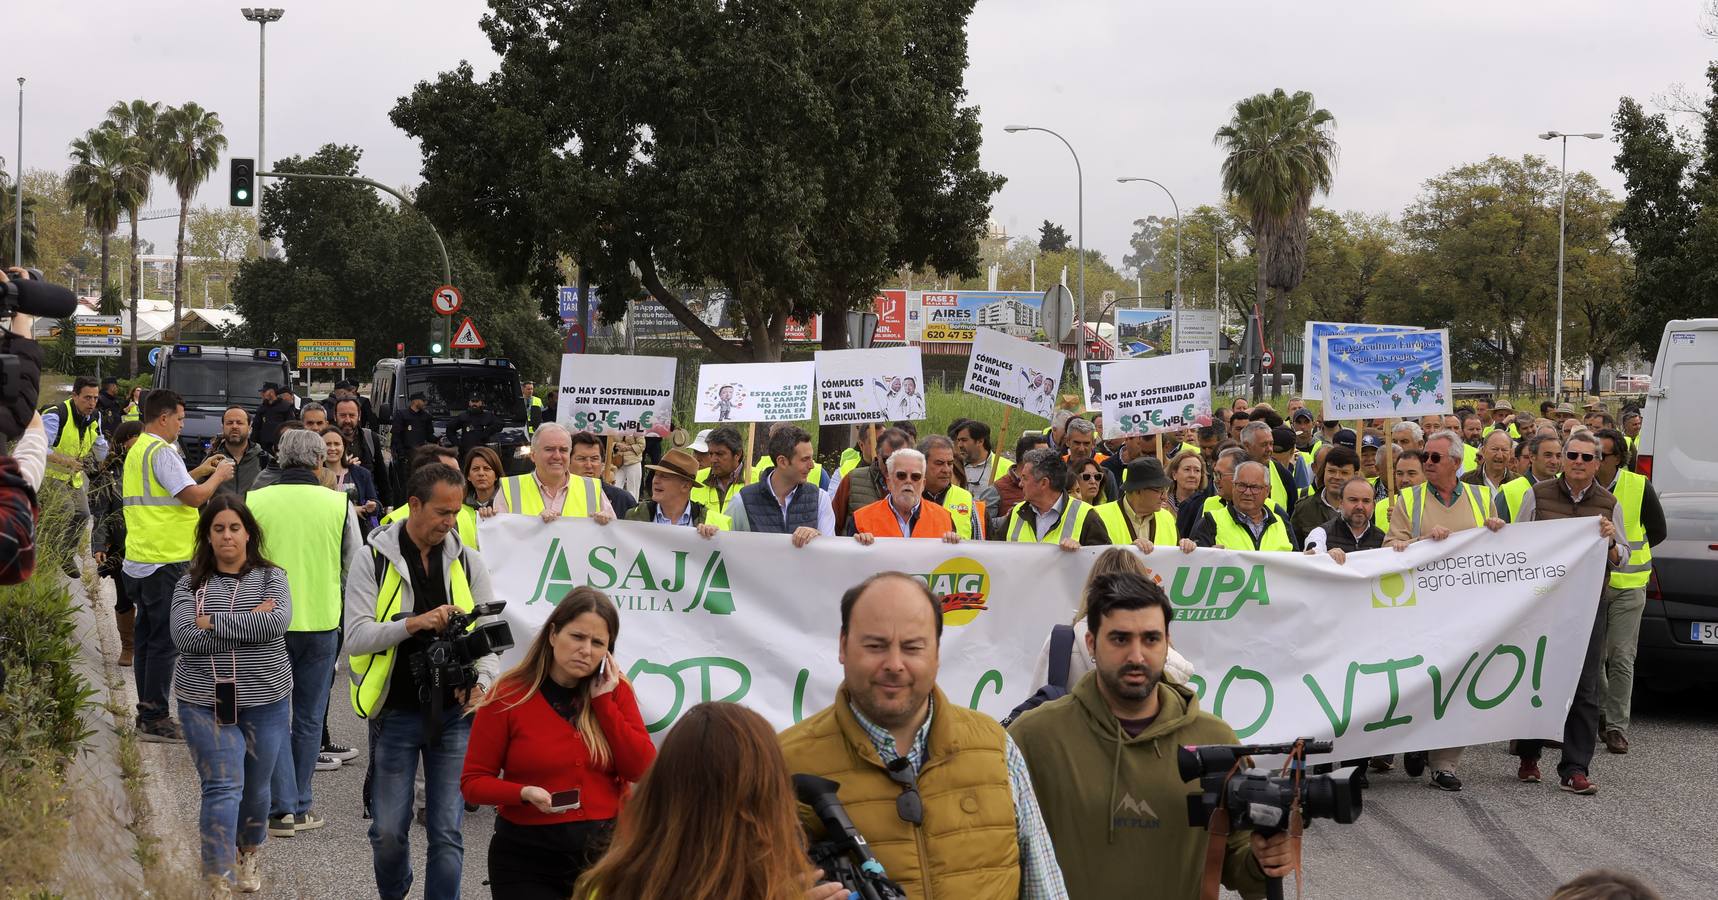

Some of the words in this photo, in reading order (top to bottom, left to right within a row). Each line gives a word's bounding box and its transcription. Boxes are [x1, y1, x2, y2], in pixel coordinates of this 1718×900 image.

[932, 309, 971, 321] AIRES
[927, 331, 945, 339] 620
[947, 331, 960, 339] 47
[962, 331, 974, 339] 53
[976, 353, 1013, 371] CÓMPLICES
[1376, 353, 1388, 362] las
[973, 362, 983, 372] DE
[985, 366, 1000, 377] UNA
[821, 378, 864, 389] CÓMPLICES
[971, 372, 987, 383] PAC
[988, 378, 1001, 388] SIN
[562, 386, 576, 394] NO
[578, 387, 597, 395] HAY
[599, 387, 670, 397] SOSTENIBILIDAD
[822, 391, 833, 399] DE
[834, 390, 852, 399] UNA
[969, 383, 1019, 404] AGRICULTORES
[1104, 393, 1118, 401] NO
[1120, 390, 1138, 399] HAY
[1140, 380, 1208, 397] SOSTENIBILIDAD
[1349, 389, 1359, 397] el
[1360, 389, 1382, 397] resto
[592, 397, 655, 406] RENTABILIDAD
[823, 401, 841, 411] PAC
[842, 401, 856, 410] SIN
[1118, 400, 1133, 409] SIN
[1135, 392, 1195, 407] RENTABILIDAD
[1335, 400, 1346, 411] de
[824, 411, 881, 422] AGRICULTORES
[525, 538, 737, 615] ASAJA
[1417, 563, 1567, 592] agro-alimentarias
[1169, 564, 1270, 607] UPA
[1175, 608, 1229, 620] EVILLA
[1303, 635, 1547, 738] VIVO!
